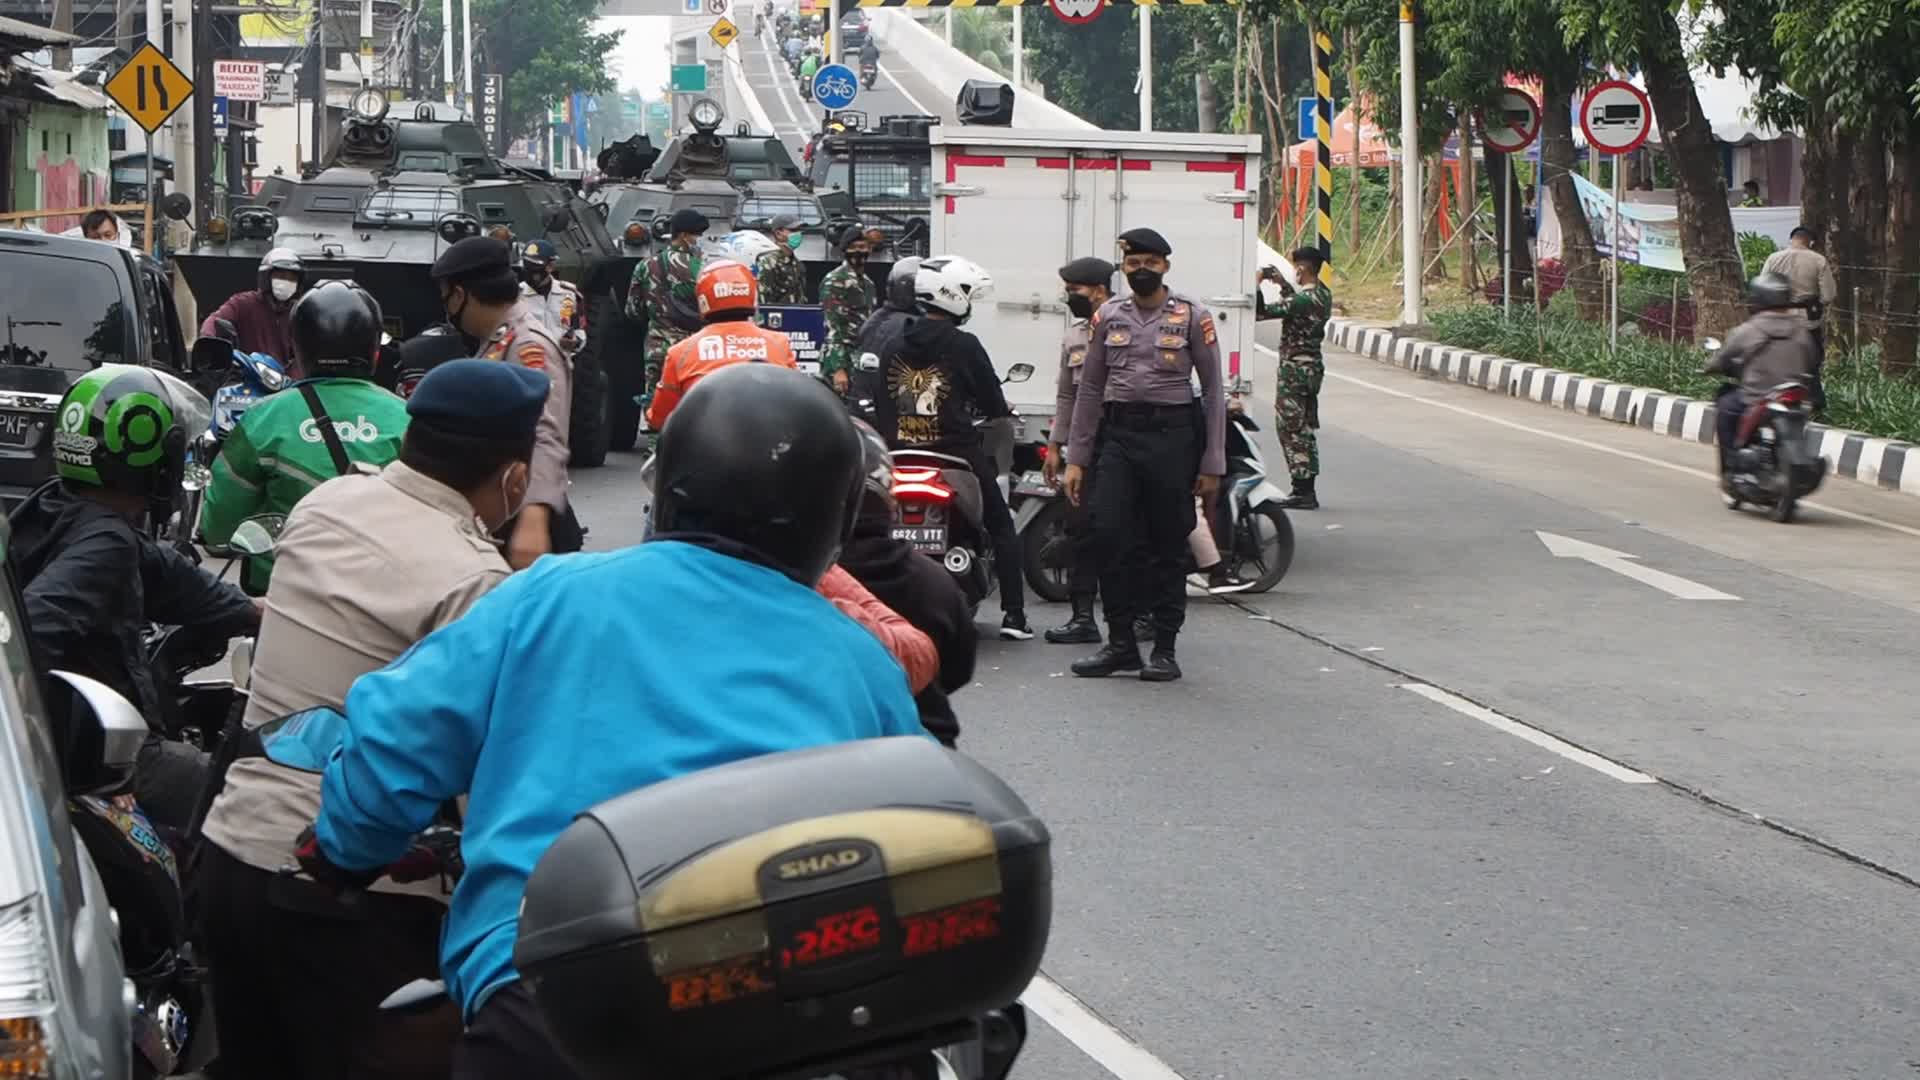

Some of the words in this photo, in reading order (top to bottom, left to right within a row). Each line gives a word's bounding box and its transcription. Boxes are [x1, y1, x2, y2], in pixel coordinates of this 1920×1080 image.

[725, 335, 767, 347] Shopee
[726, 345, 768, 359] Food
[779, 849, 861, 879] SHAD
